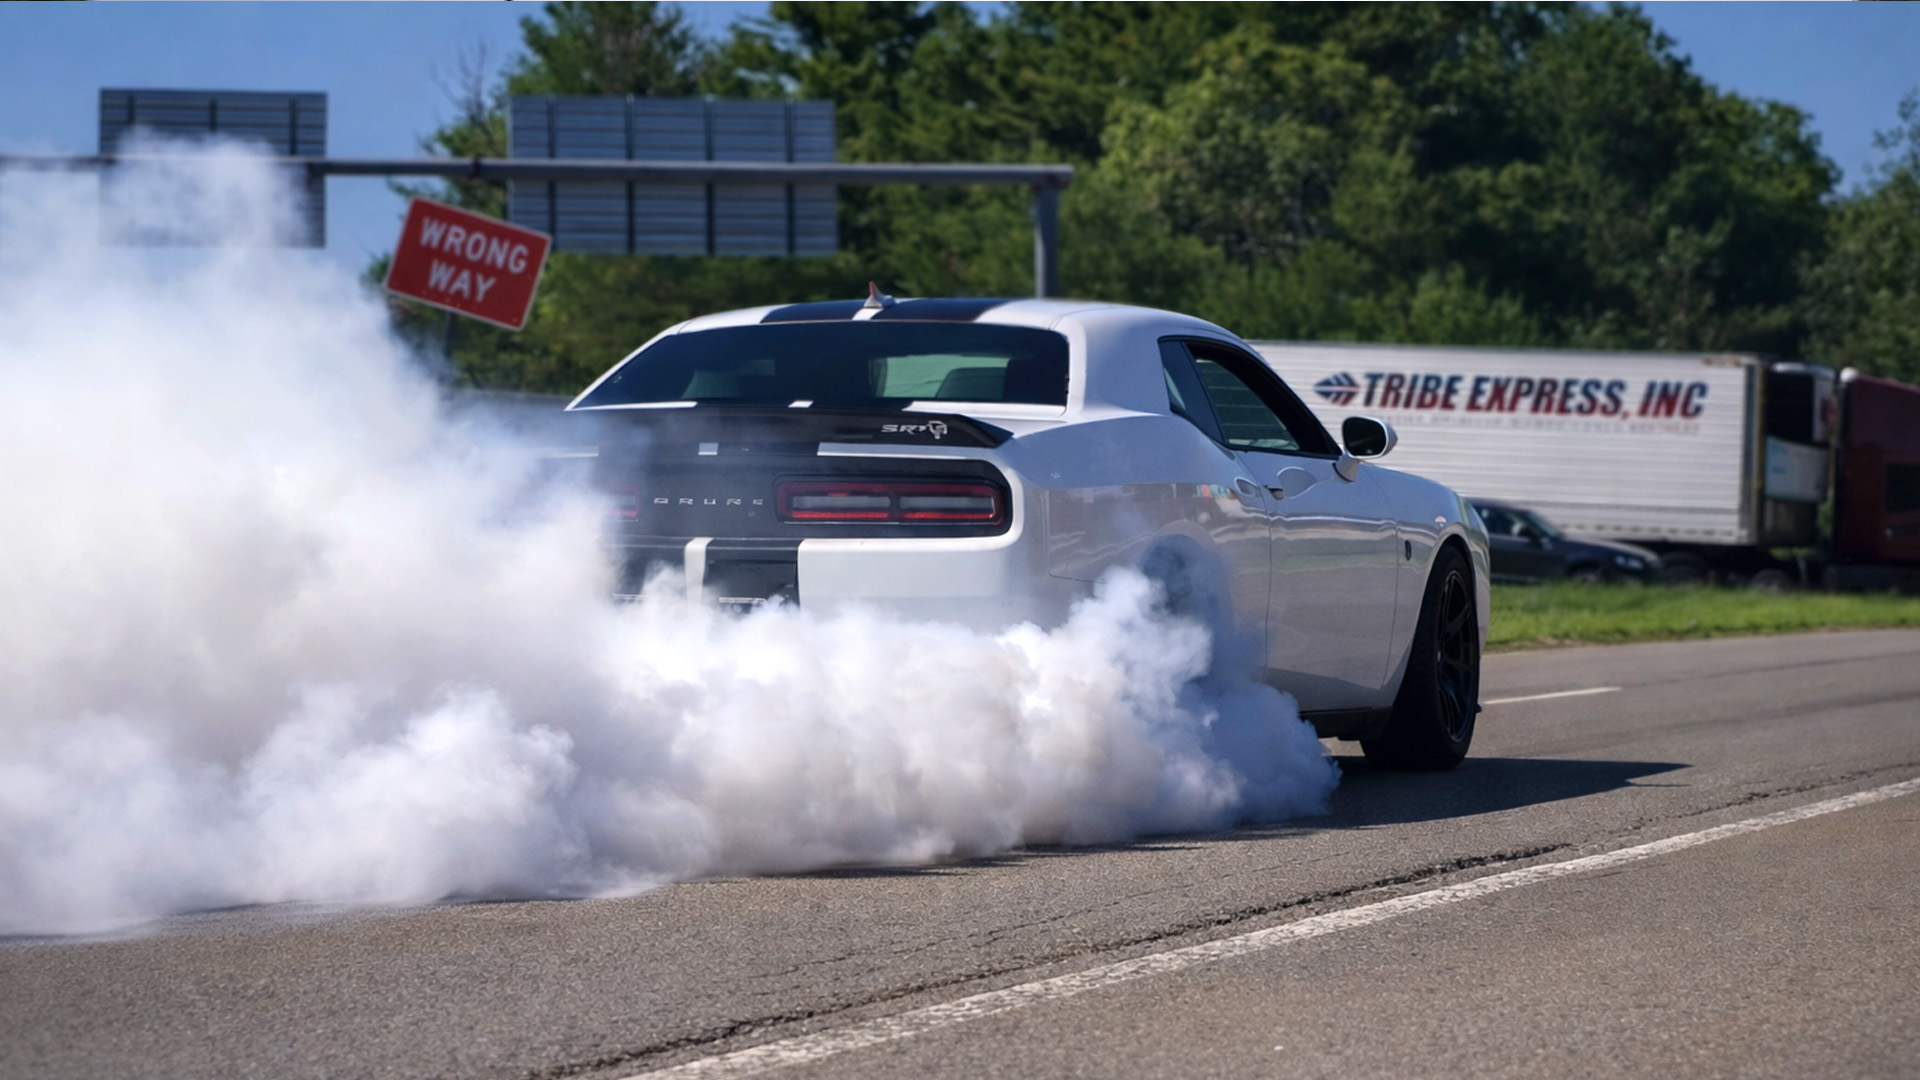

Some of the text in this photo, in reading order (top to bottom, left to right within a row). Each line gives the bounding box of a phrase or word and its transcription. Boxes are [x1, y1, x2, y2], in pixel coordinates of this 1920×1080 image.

[420, 216, 529, 275] WRONG
[428, 258, 497, 304] WAY
[1363, 372, 1709, 420] TRIBE EXPRESS, INC
